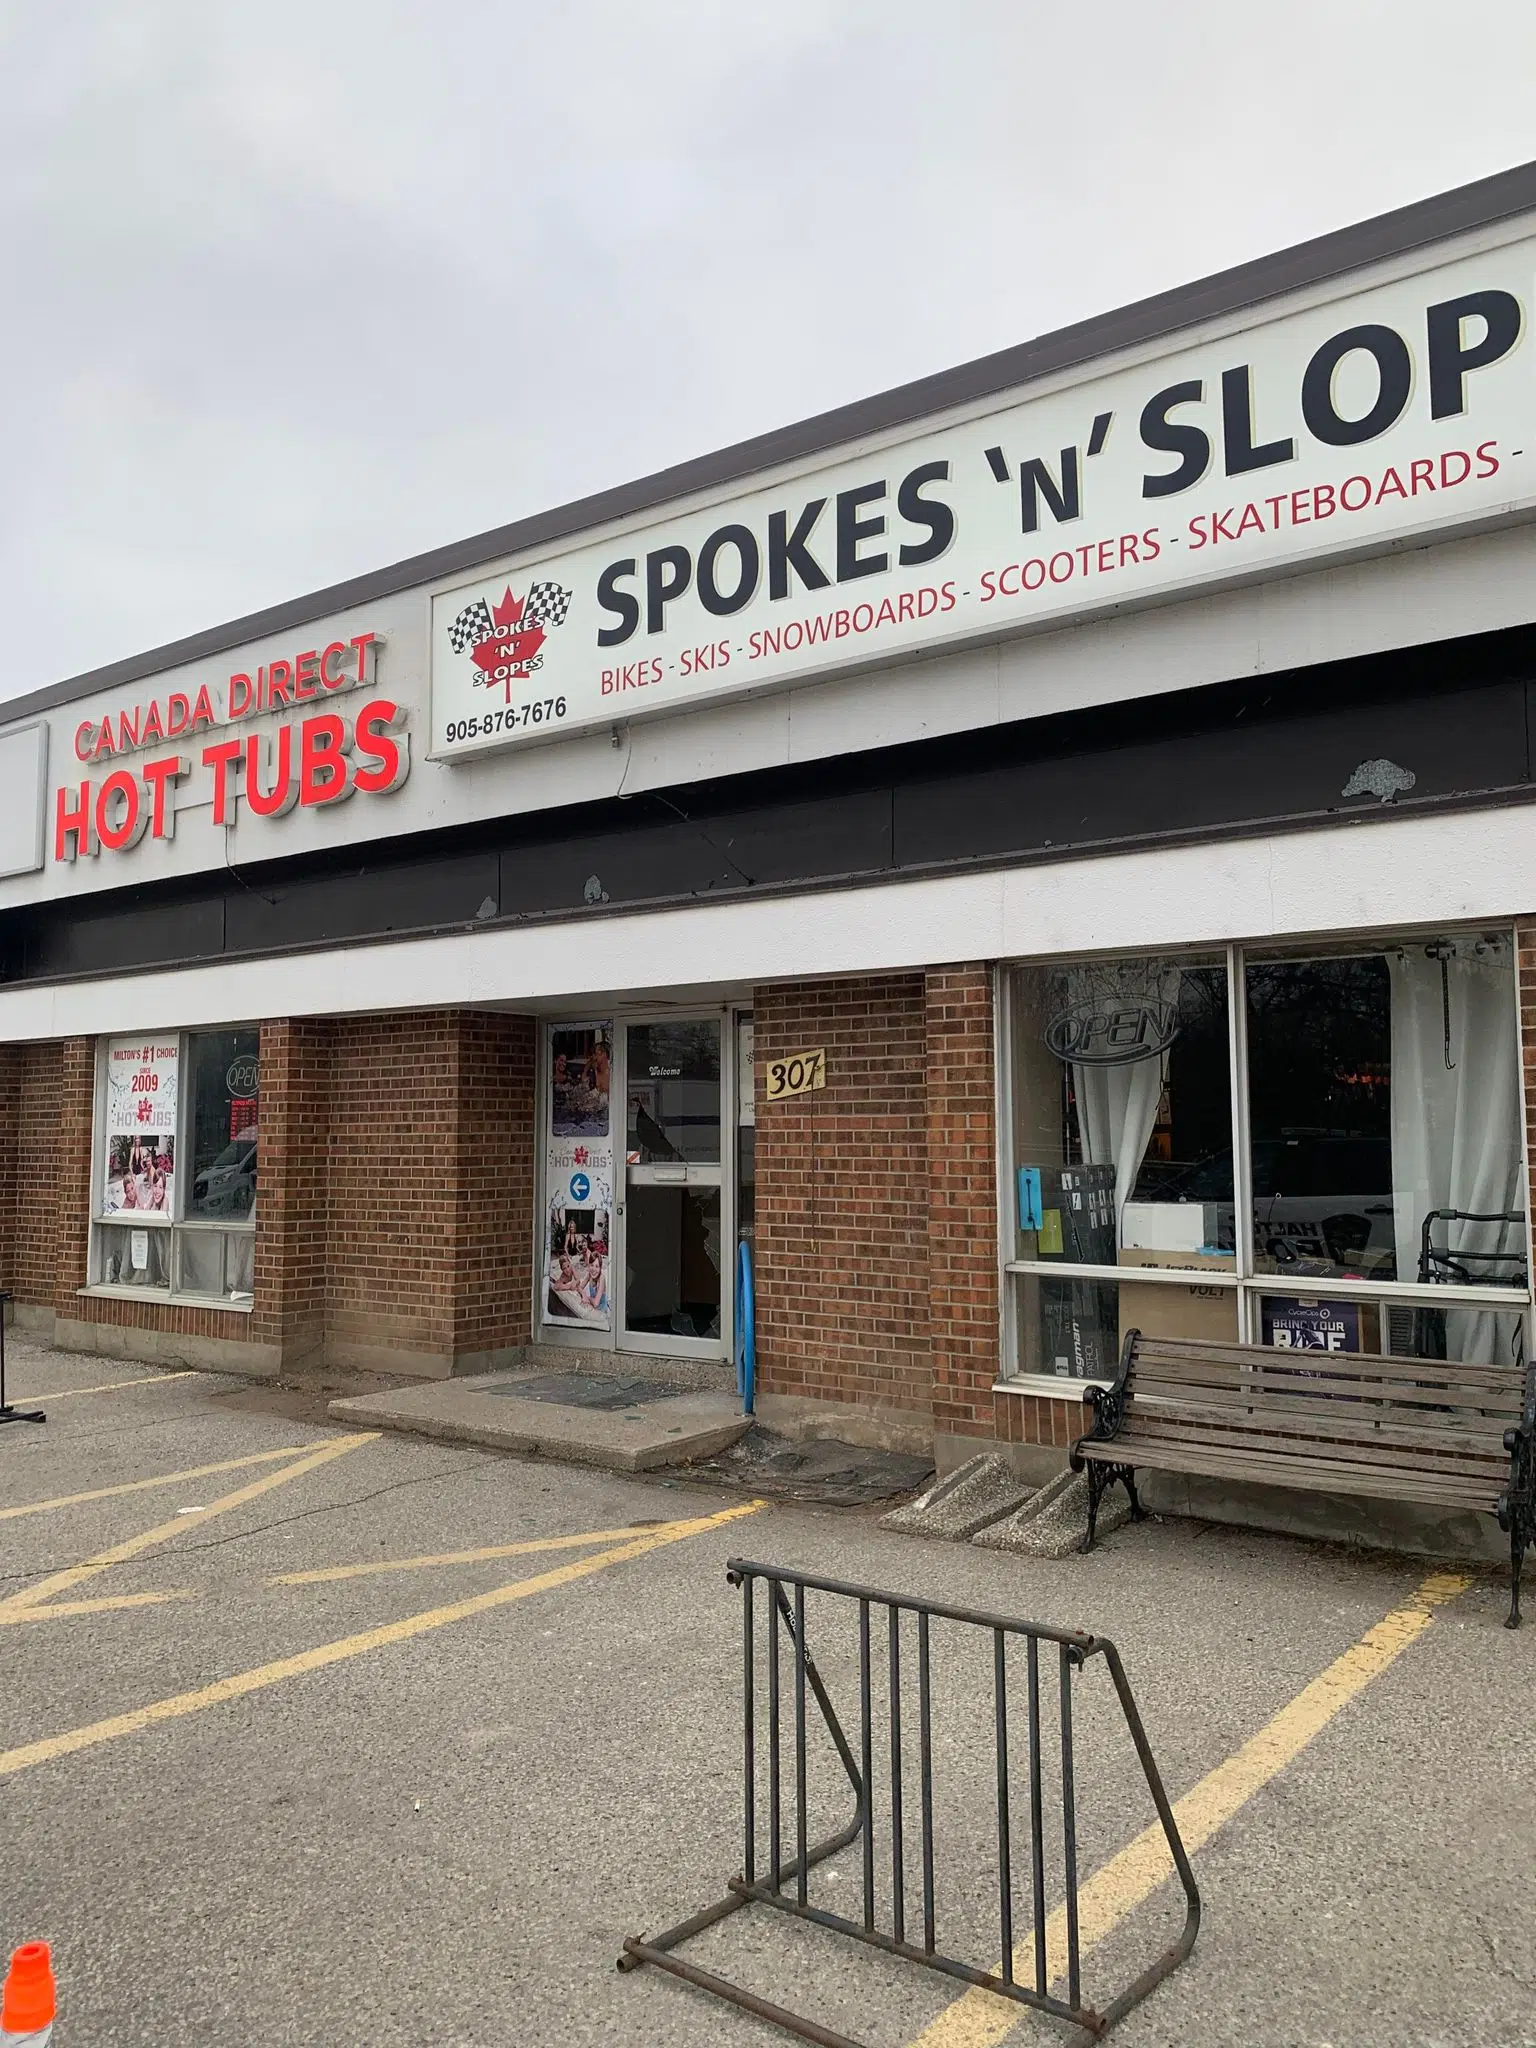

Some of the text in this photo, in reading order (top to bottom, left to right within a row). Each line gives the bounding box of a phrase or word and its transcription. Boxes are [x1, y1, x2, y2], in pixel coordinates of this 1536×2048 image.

[597, 461, 956, 648] SPOKES
[601, 657, 664, 695] BIKES
[680, 640, 731, 677] SKIS
[748, 581, 957, 659] SNOWBOARDS
[980, 528, 1162, 602] SCOOTERS
[1188, 441, 1501, 550] SKATEBOARDS
[471, 614, 546, 647] SPOKES
[472, 654, 544, 687] SLOPES
[74, 631, 378, 762] CANADA DIRECT
[446, 696, 567, 743] 905-876-7676
[55, 699, 402, 862] HOT TUBS
[1052, 1004, 1176, 1051] OPEN
[114, 1045, 178, 1064] MILTON'S #1 CHOICE
[648, 1066, 681, 1076] Welcome
[131, 1074, 159, 1094] 2009
[769, 1053, 821, 1094] 307
[117, 1111, 138, 1127] HOT
[554, 1156, 574, 1168] HOT
[1288, 1308, 1319, 1317] CycleOps
[1311, 1321, 1345, 1332] YOUR
